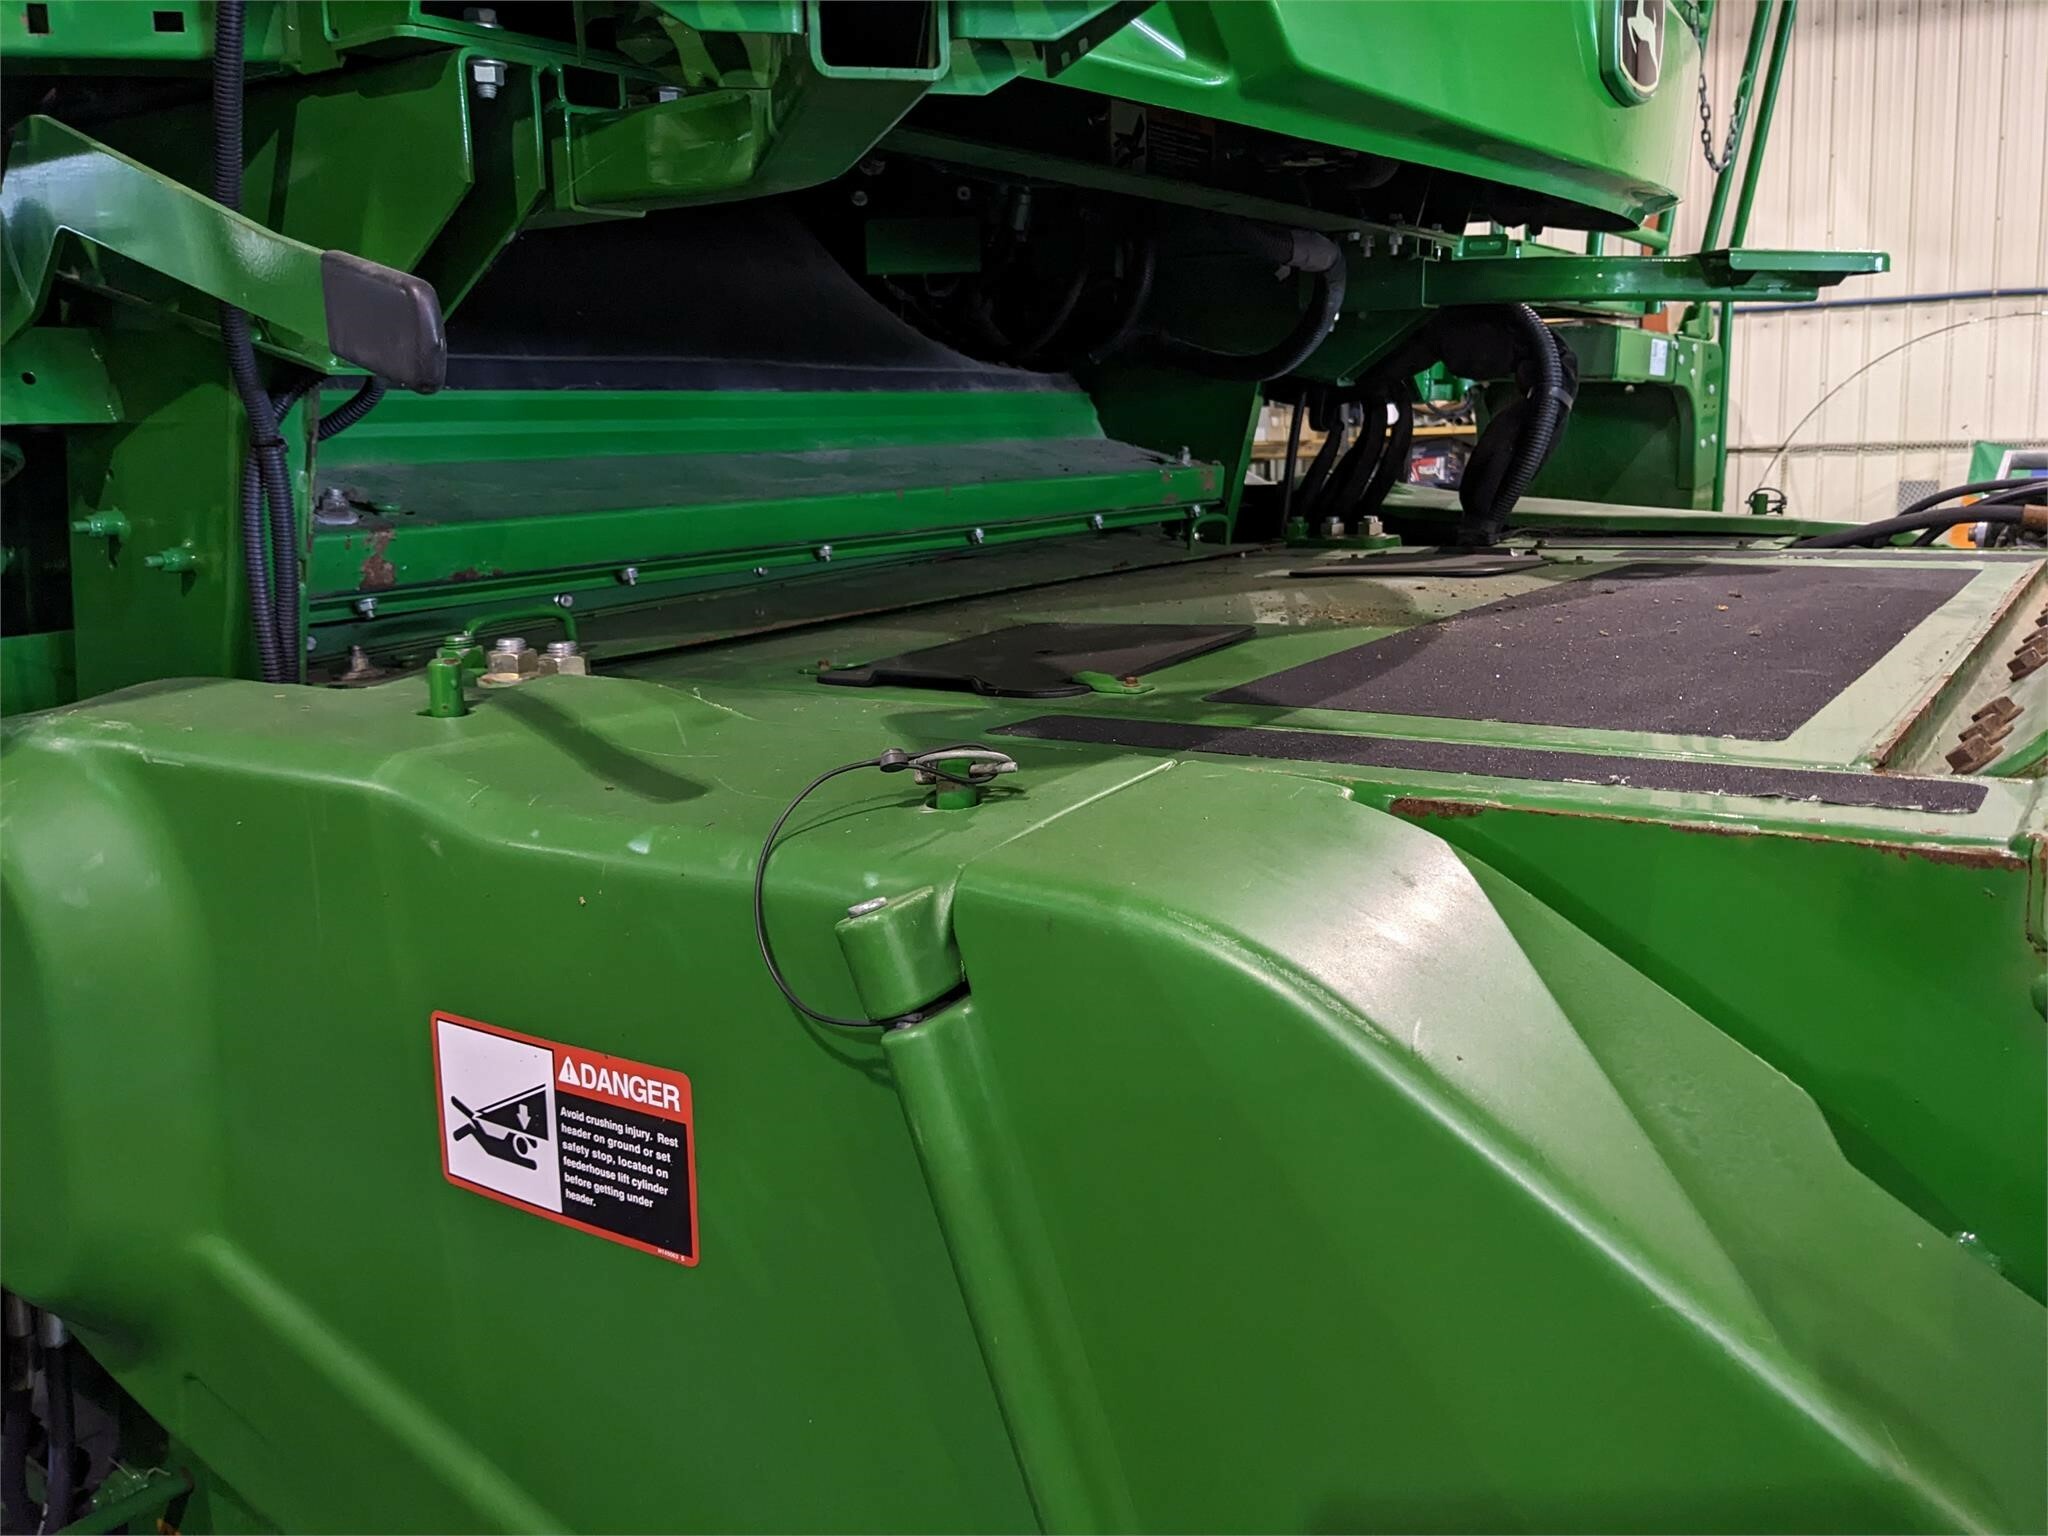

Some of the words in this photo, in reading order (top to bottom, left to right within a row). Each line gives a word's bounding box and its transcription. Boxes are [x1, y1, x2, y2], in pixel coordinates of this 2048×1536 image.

[580, 1062, 681, 1112] DANGER
[560, 1106, 585, 1122] Avoid
[585, 1115, 624, 1135] crushing
[625, 1124, 653, 1142] injury.
[657, 1132, 679, 1148] Rest
[560, 1123, 591, 1140] header
[593, 1132, 605, 1144] on
[607, 1137, 641, 1154] ground
[643, 1147, 654, 1158] or
[656, 1150, 671, 1163] set
[562, 1140, 590, 1158] safety
[592, 1148, 616, 1165] stop,
[618, 1156, 654, 1175] located
[655, 1168, 669, 1180] on
[563, 1156, 616, 1180] feederhouse
[617, 1172, 630, 1185] lift
[631, 1176, 669, 1196] cylinder
[564, 1172, 592, 1190] before
[593, 1182, 625, 1202] getting
[627, 1192, 654, 1208] under
[565, 1188, 597, 1207] header.
